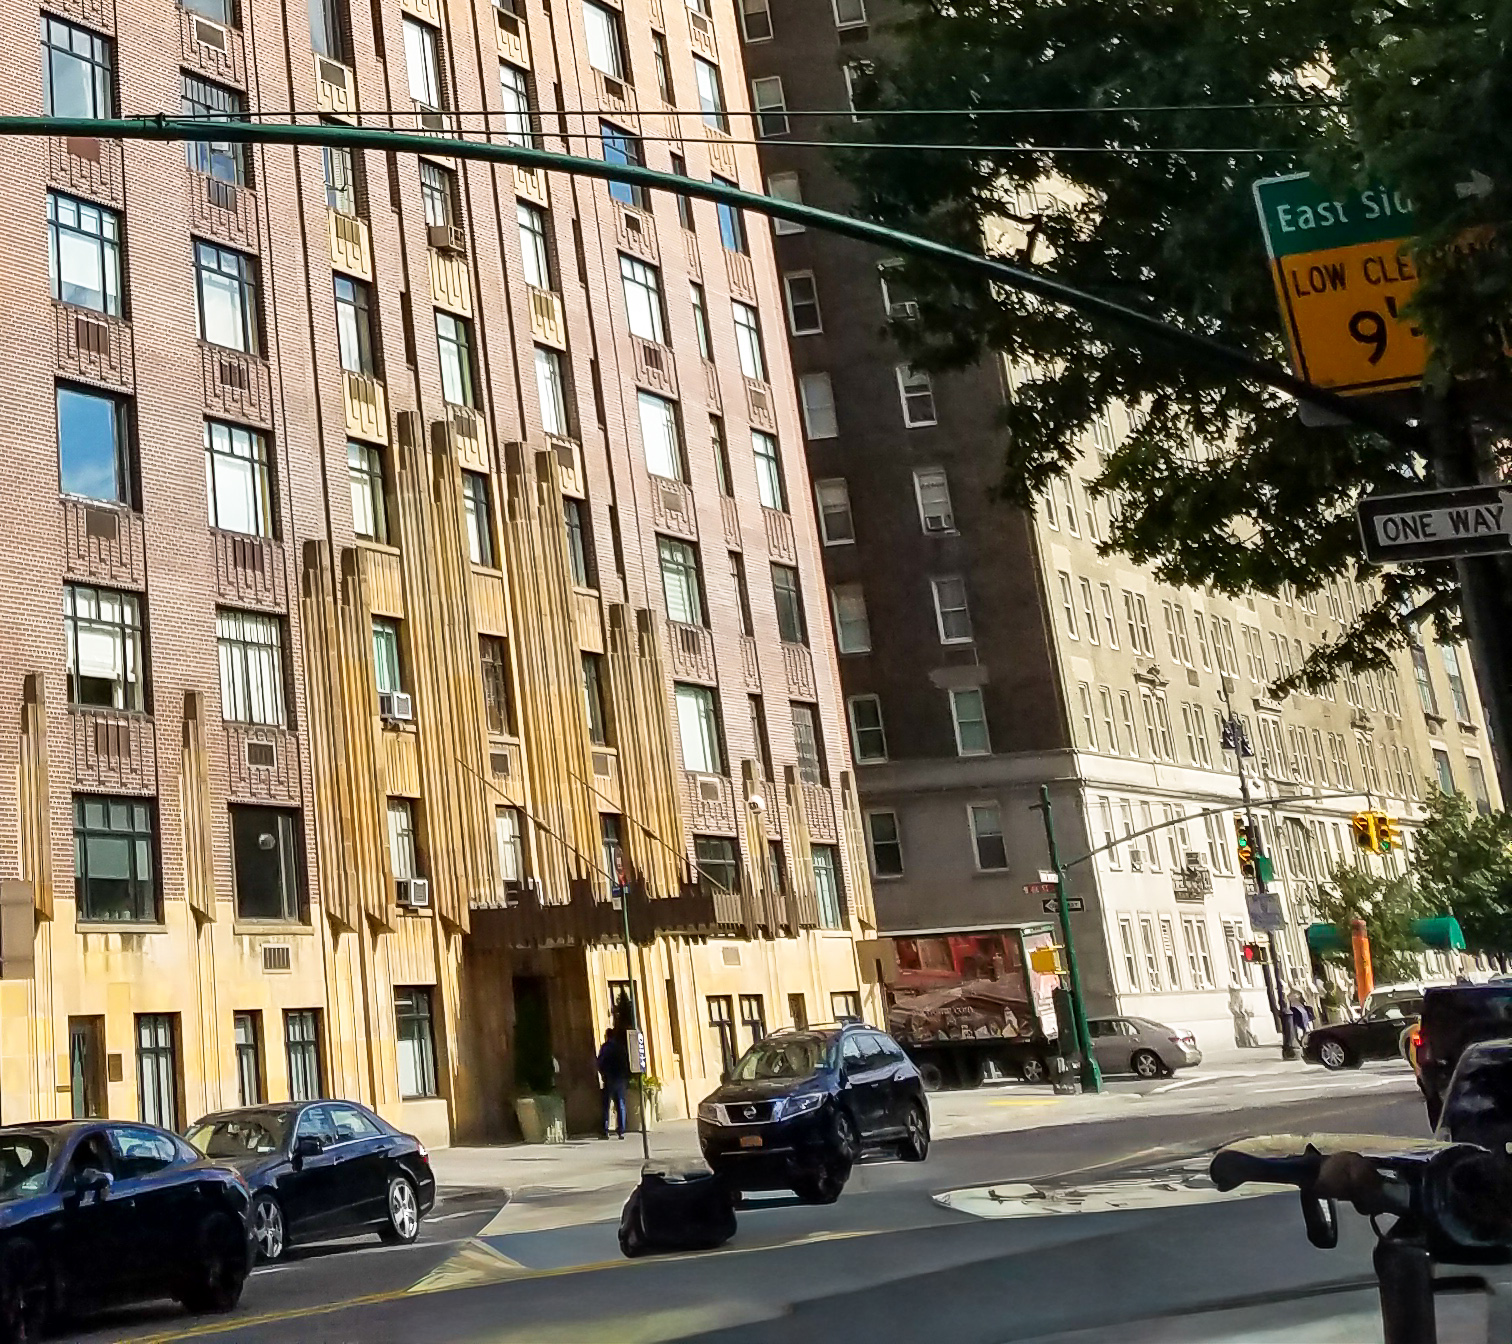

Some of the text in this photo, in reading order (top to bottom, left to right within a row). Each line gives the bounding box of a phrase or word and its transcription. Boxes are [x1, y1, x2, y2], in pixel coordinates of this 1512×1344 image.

[1276, 201, 1348, 233] East
[1291, 263, 1347, 299] LOW
[1382, 505, 1504, 542] ONE WAY
